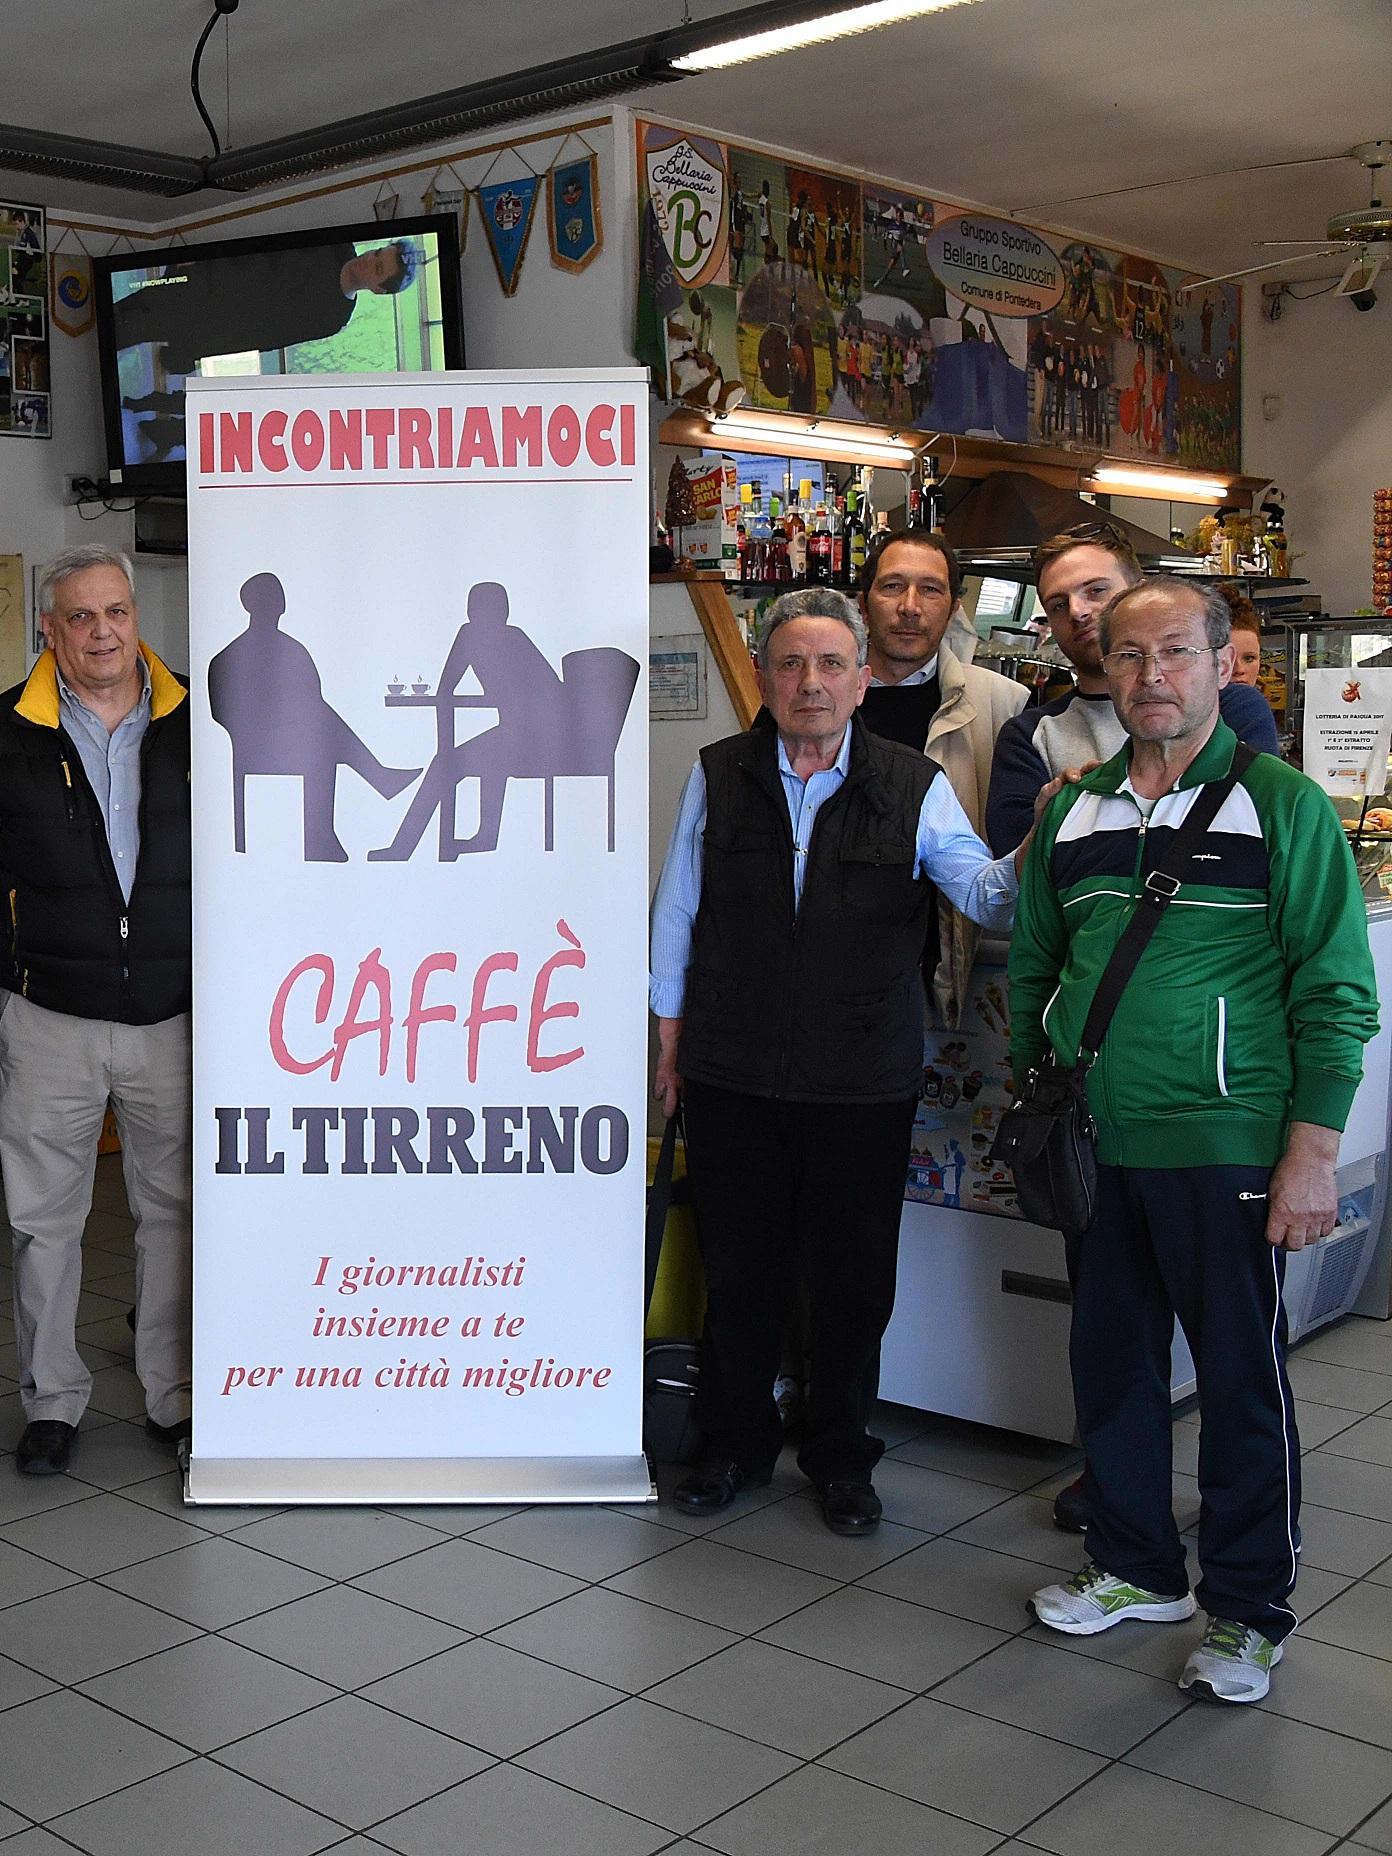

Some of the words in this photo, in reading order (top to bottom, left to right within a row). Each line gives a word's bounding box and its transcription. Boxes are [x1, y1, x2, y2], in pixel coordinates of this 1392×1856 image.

[652, 165, 717, 194] Cappuccini
[664, 156, 713, 182] Bellaria
[960, 220, 999, 244] Gruppo
[1001, 230, 1042, 256] Sportivo
[943, 241, 988, 271] Bellaria
[992, 254, 1056, 287] Cappuccini
[961, 281, 994, 300] Comune
[995, 290, 1003, 302] di
[1004, 291, 1042, 311] Pontedera
[199, 403, 636, 474] INCONTRIAMOCI
[693, 479, 716, 495] SAN
[269, 918, 586, 1084] CAFFÈ
[214, 1106, 285, 1175] IL
[292, 1104, 630, 1175] TIRRENO
[312, 1256, 333, 1287] I
[338, 1256, 527, 1295] giornalisti
[312, 1307, 450, 1338] insieme
[460, 1317, 482, 1338] a
[493, 1312, 526, 1338] te
[220, 1363, 283, 1396] per
[295, 1364, 362, 1388] una
[374, 1357, 450, 1389] città
[462, 1358, 612, 1397] migliore
